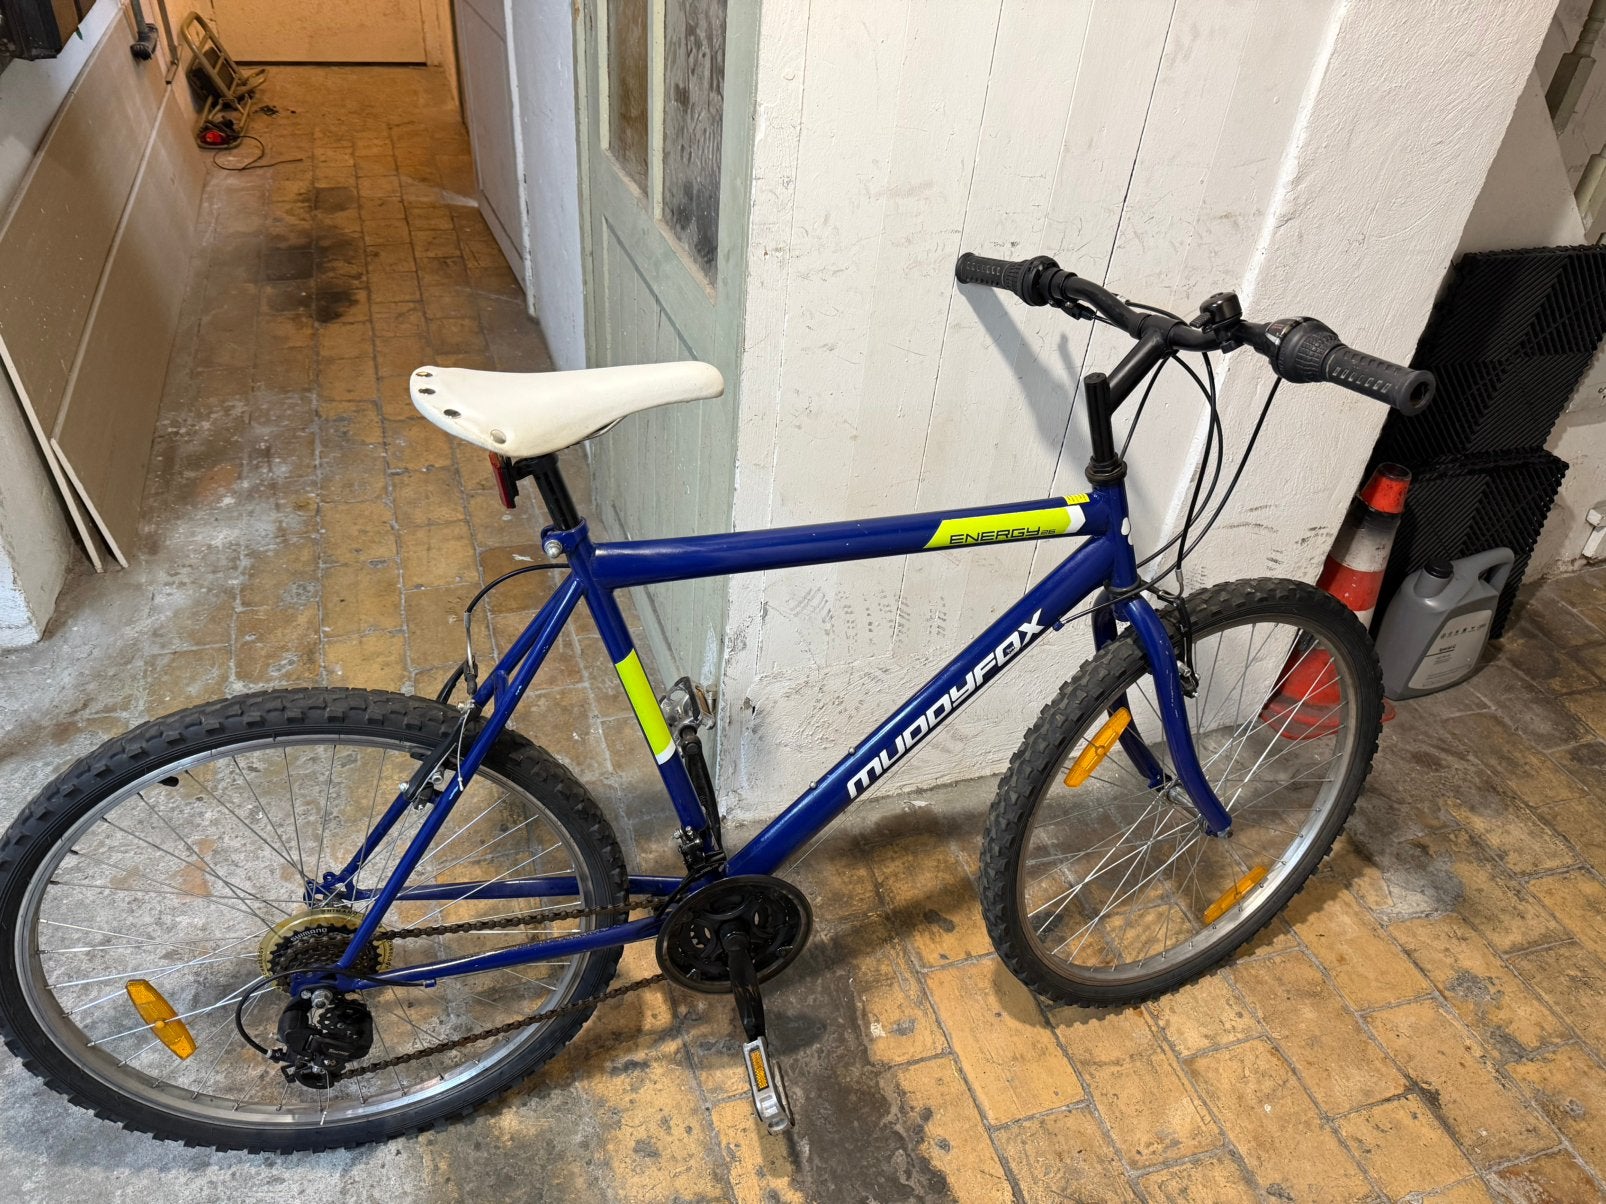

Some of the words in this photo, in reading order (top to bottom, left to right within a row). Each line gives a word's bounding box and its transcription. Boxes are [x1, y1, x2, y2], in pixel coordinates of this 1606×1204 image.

[949, 526, 1041, 545] ENERGY
[846, 608, 1045, 800] MUDDYFOX
[320, 908, 359, 917] SHIMANO
[290, 927, 328, 941] SHIMANO
